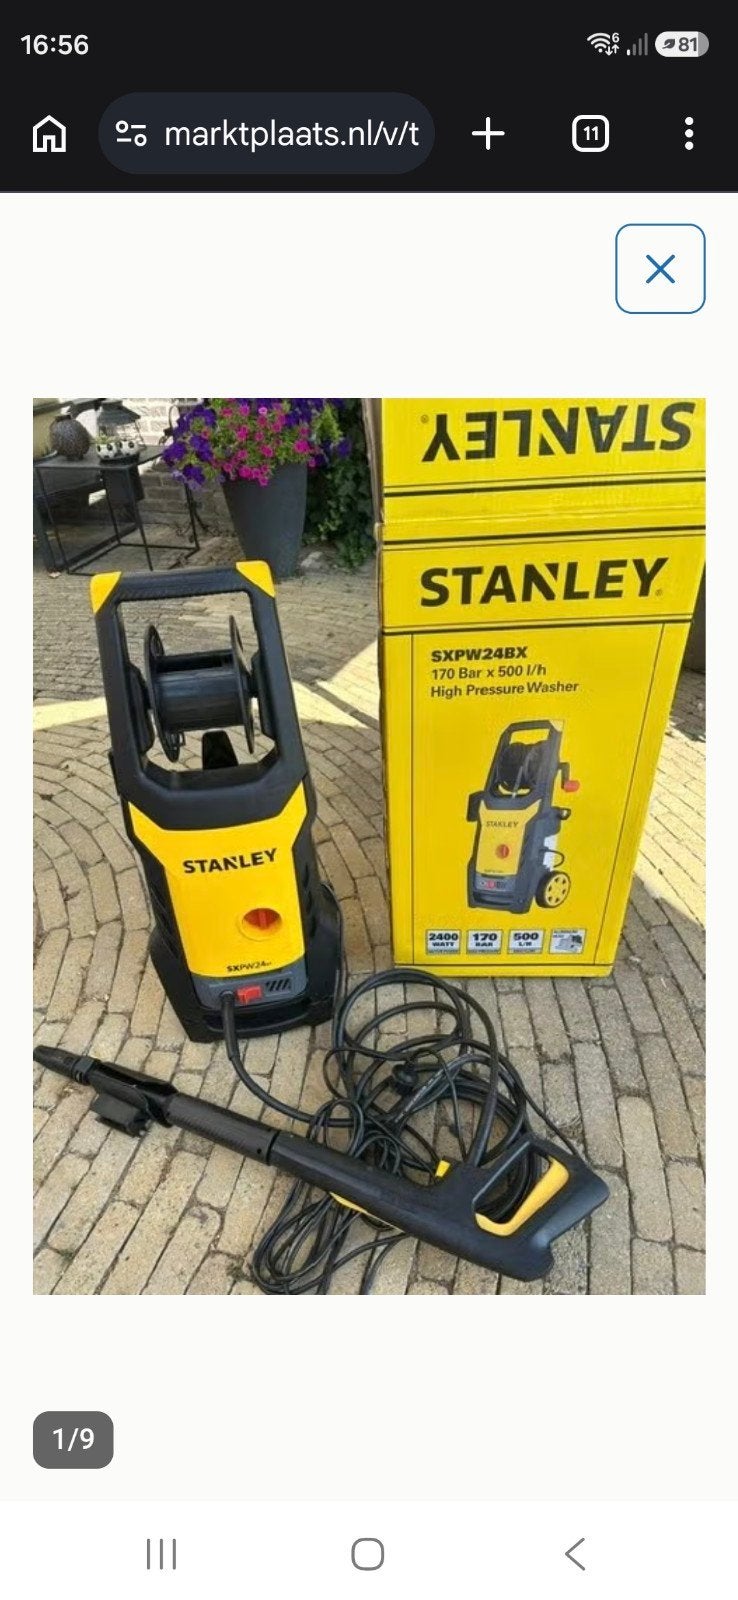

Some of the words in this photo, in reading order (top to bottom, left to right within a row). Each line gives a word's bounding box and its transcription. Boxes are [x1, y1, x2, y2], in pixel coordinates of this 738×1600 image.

[21, 34, 89, 55] 16:56
[611, 32, 620, 43] 6
[678, 37, 697, 52] 81
[164, 119, 419, 152] marktplaats.nl/v/t
[583, 126, 599, 141] 11
[421, 402, 696, 462] STANLEY
[420, 557, 669, 607] STANLEY
[430, 646, 528, 663] SXPW24BX
[432, 668, 455, 680] 170
[459, 667, 481, 679] Bar
[486, 669, 494, 677] x
[498, 665, 523, 677] 500
[431, 685, 462, 699] High
[466, 684, 525, 696] Pressure
[526, 681, 579, 693] Washer
[182, 848, 277, 874] STANLEY
[429, 932, 459, 941] 2400
[472, 932, 498, 941] 170
[514, 932, 539, 941] 500
[52, 1428, 95, 1451] 1/9
